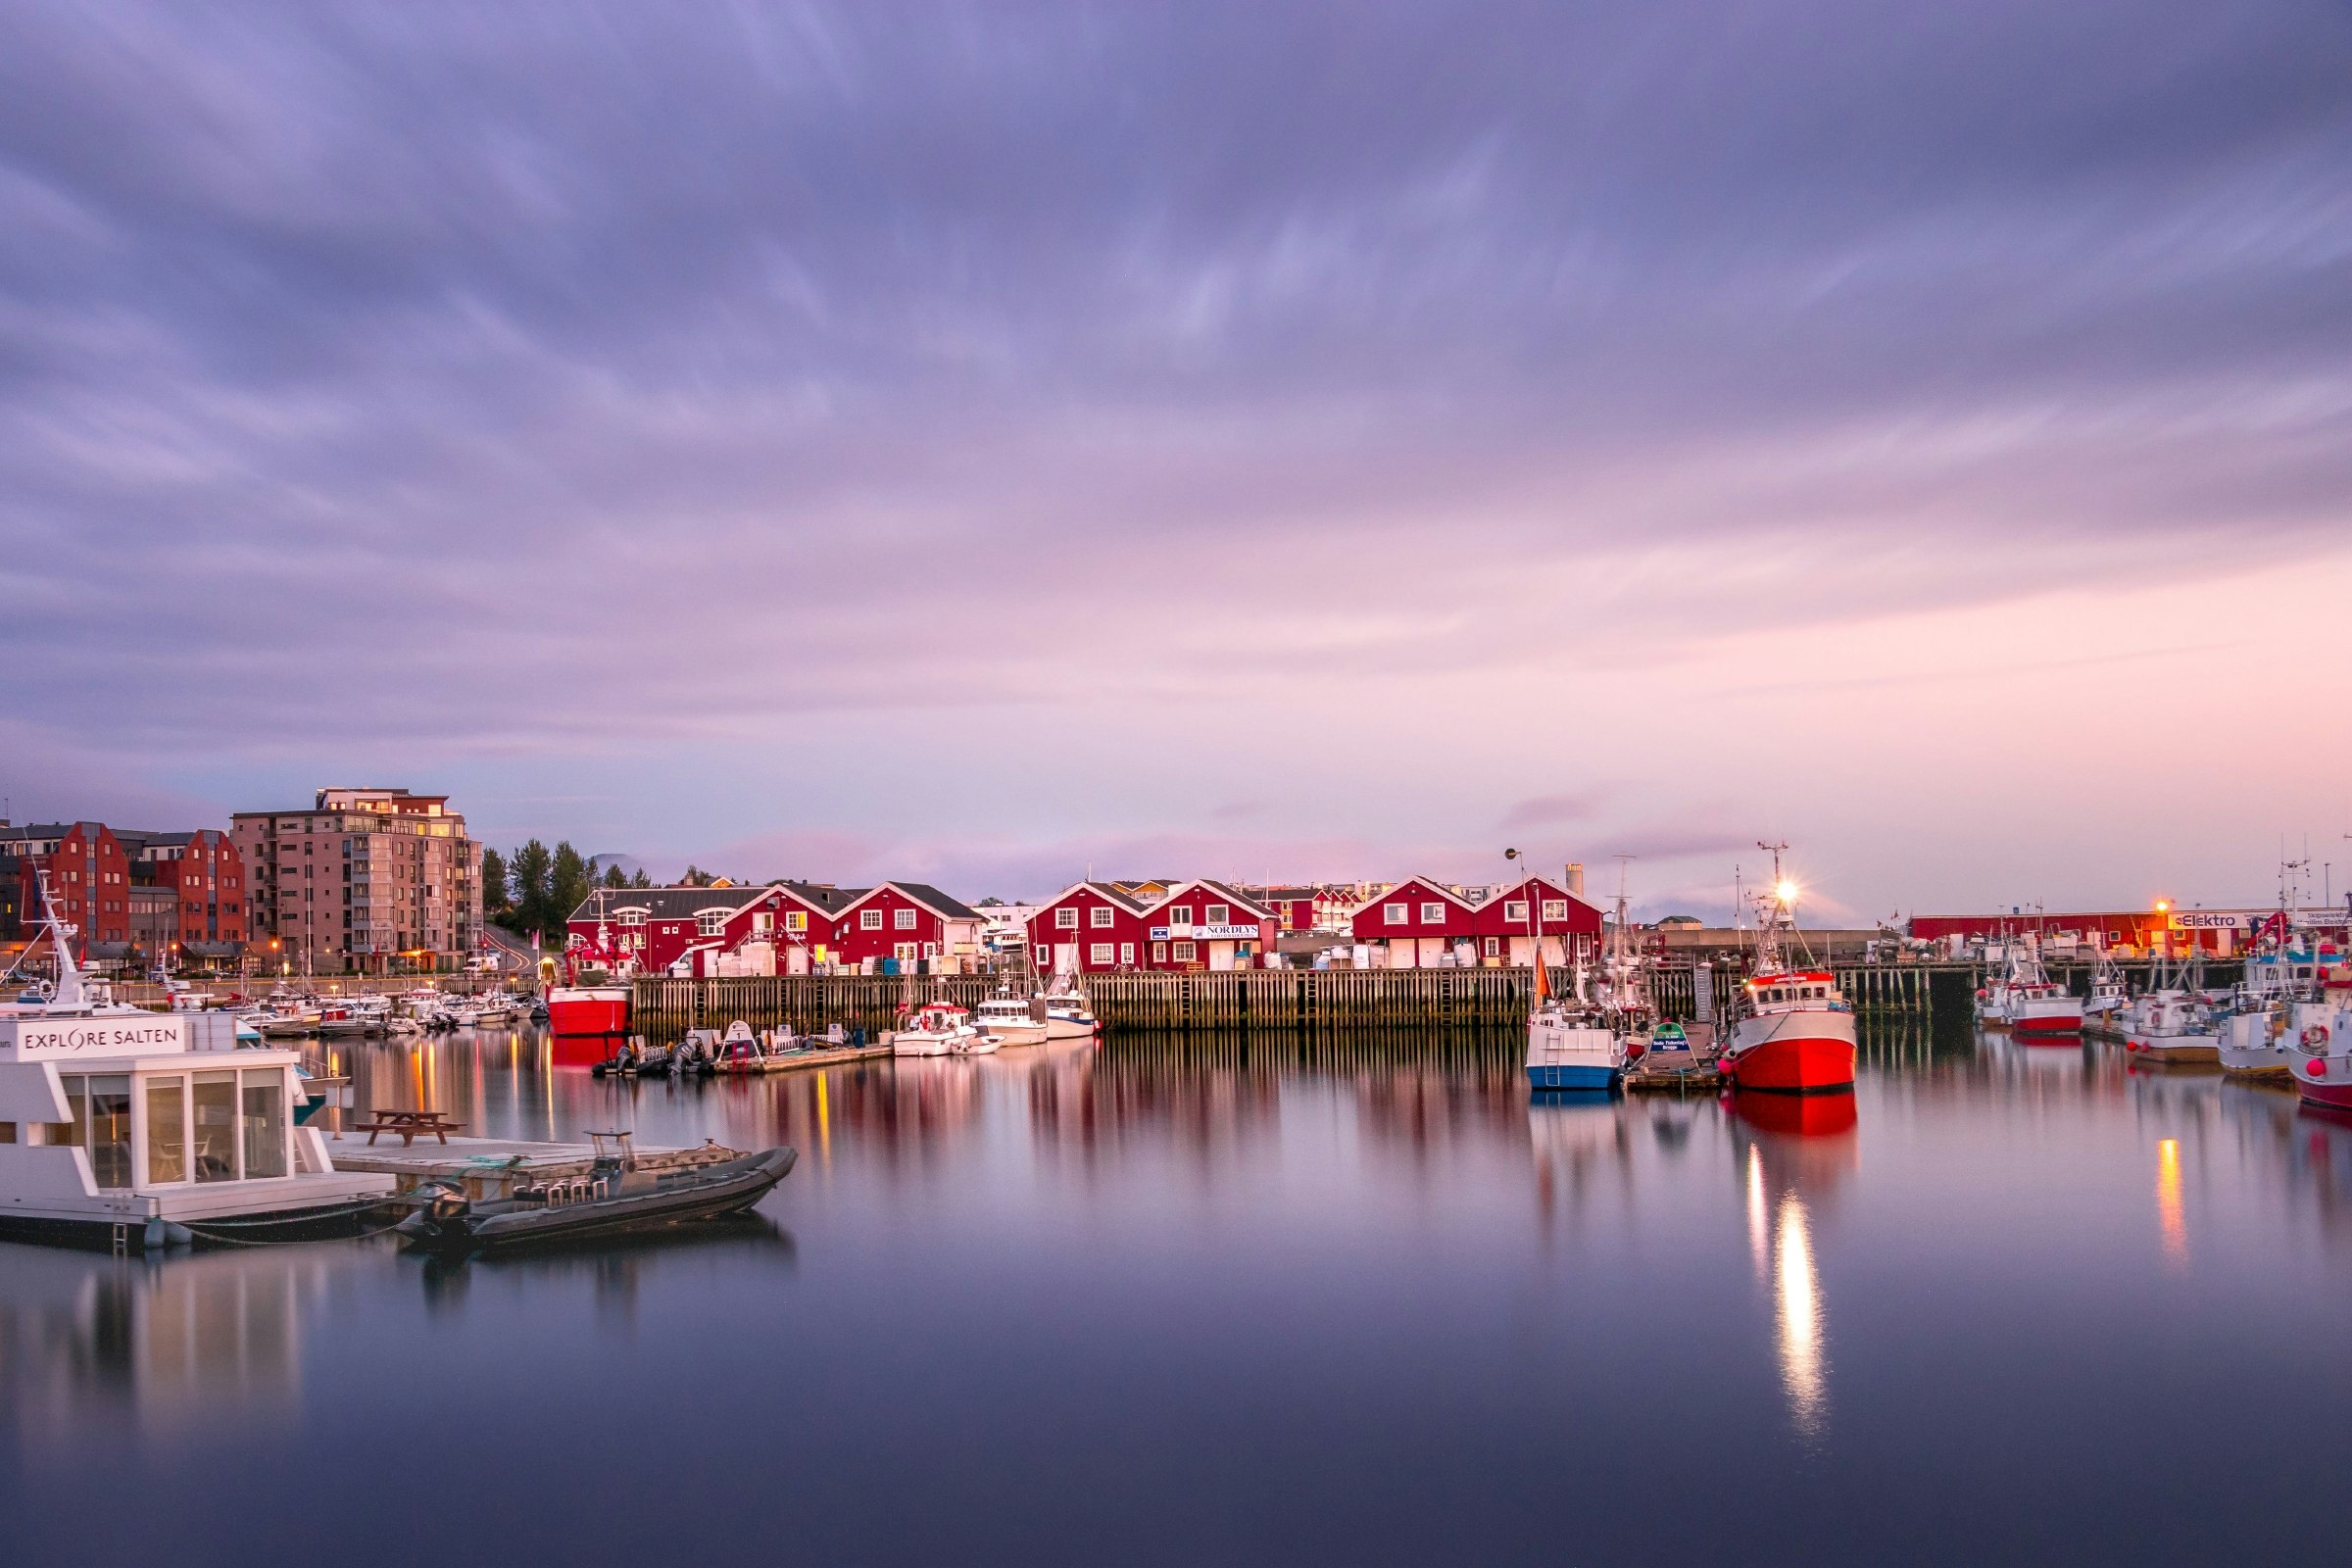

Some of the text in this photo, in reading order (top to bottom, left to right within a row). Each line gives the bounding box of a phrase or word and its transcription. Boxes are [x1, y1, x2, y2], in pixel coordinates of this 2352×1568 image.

[2181, 914, 2235, 926] Elektro
[1207, 925, 1257, 934] NORDLYS
[25, 1028, 177, 1051] EXPLORE SALTEN
